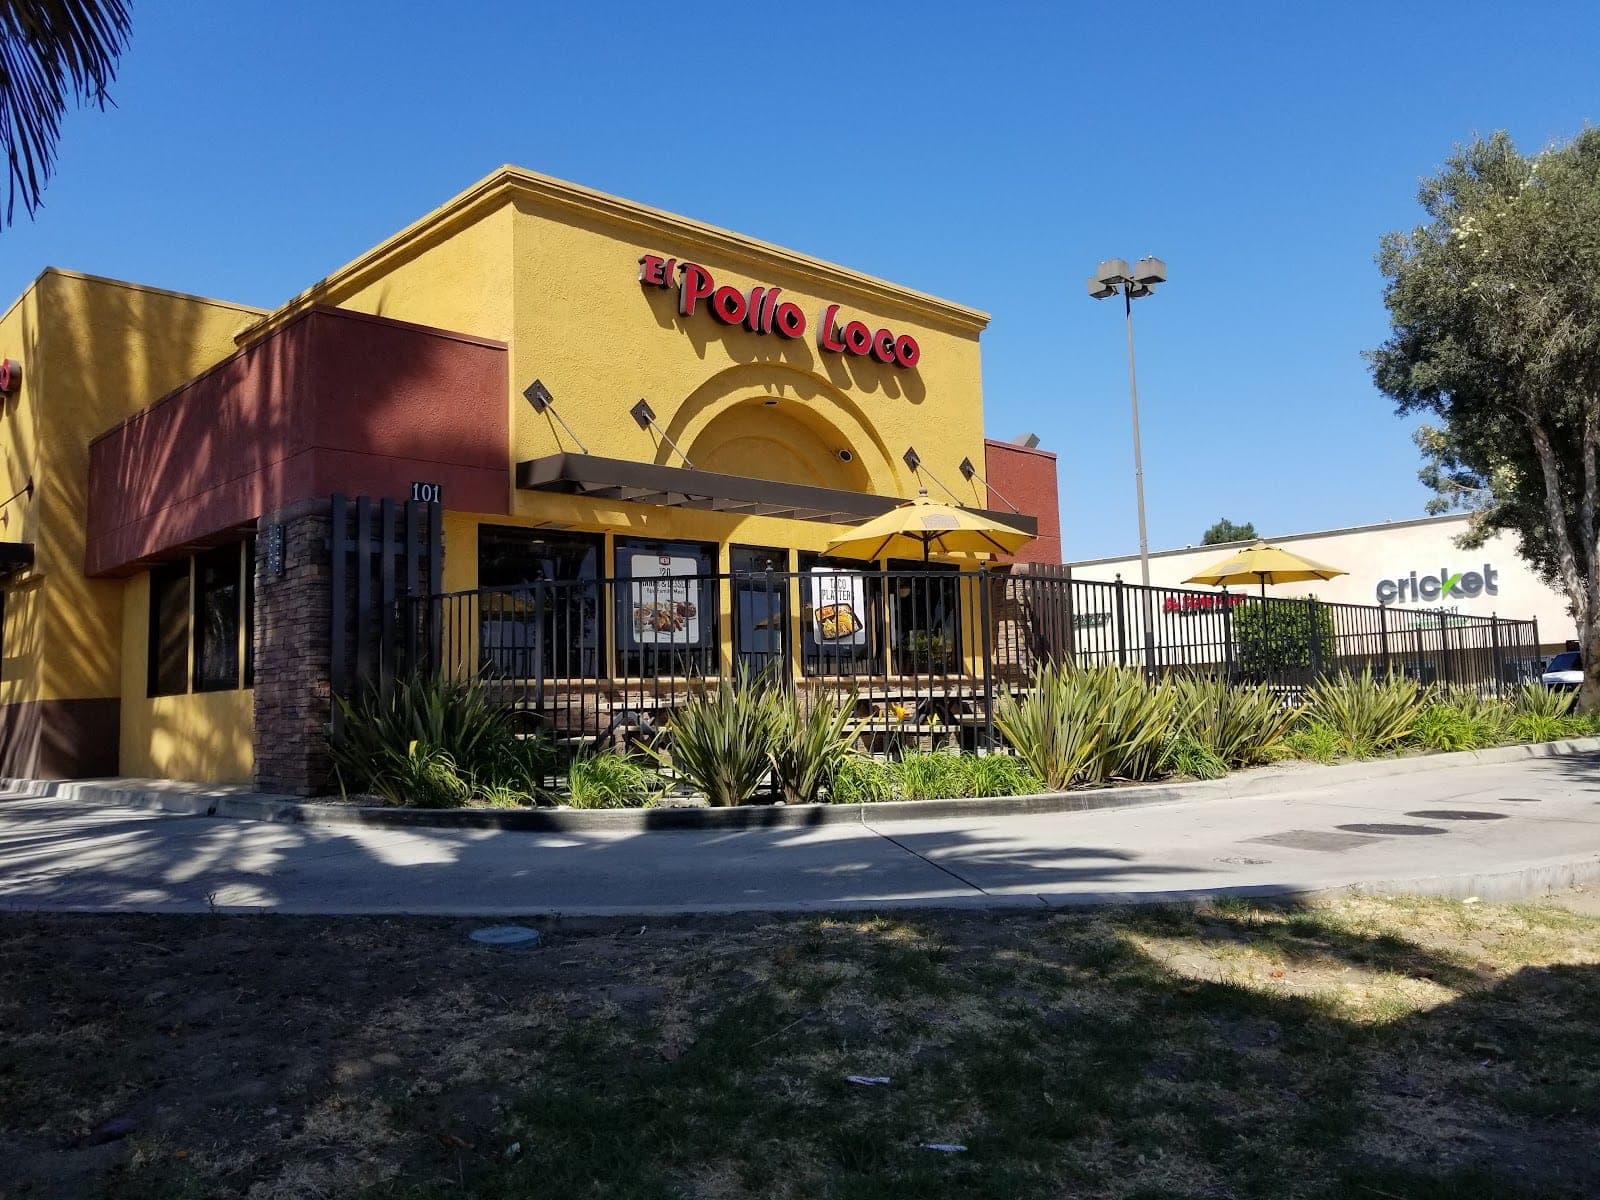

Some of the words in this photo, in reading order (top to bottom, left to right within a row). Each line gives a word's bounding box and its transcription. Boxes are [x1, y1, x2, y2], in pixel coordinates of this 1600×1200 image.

[639, 254, 676, 288] El
[678, 262, 806, 339] Pollo
[817, 304, 920, 368] Loco
[413, 483, 439, 503] 101
[821, 589, 850, 600] PLATER
[1376, 563, 1498, 603] cricket
